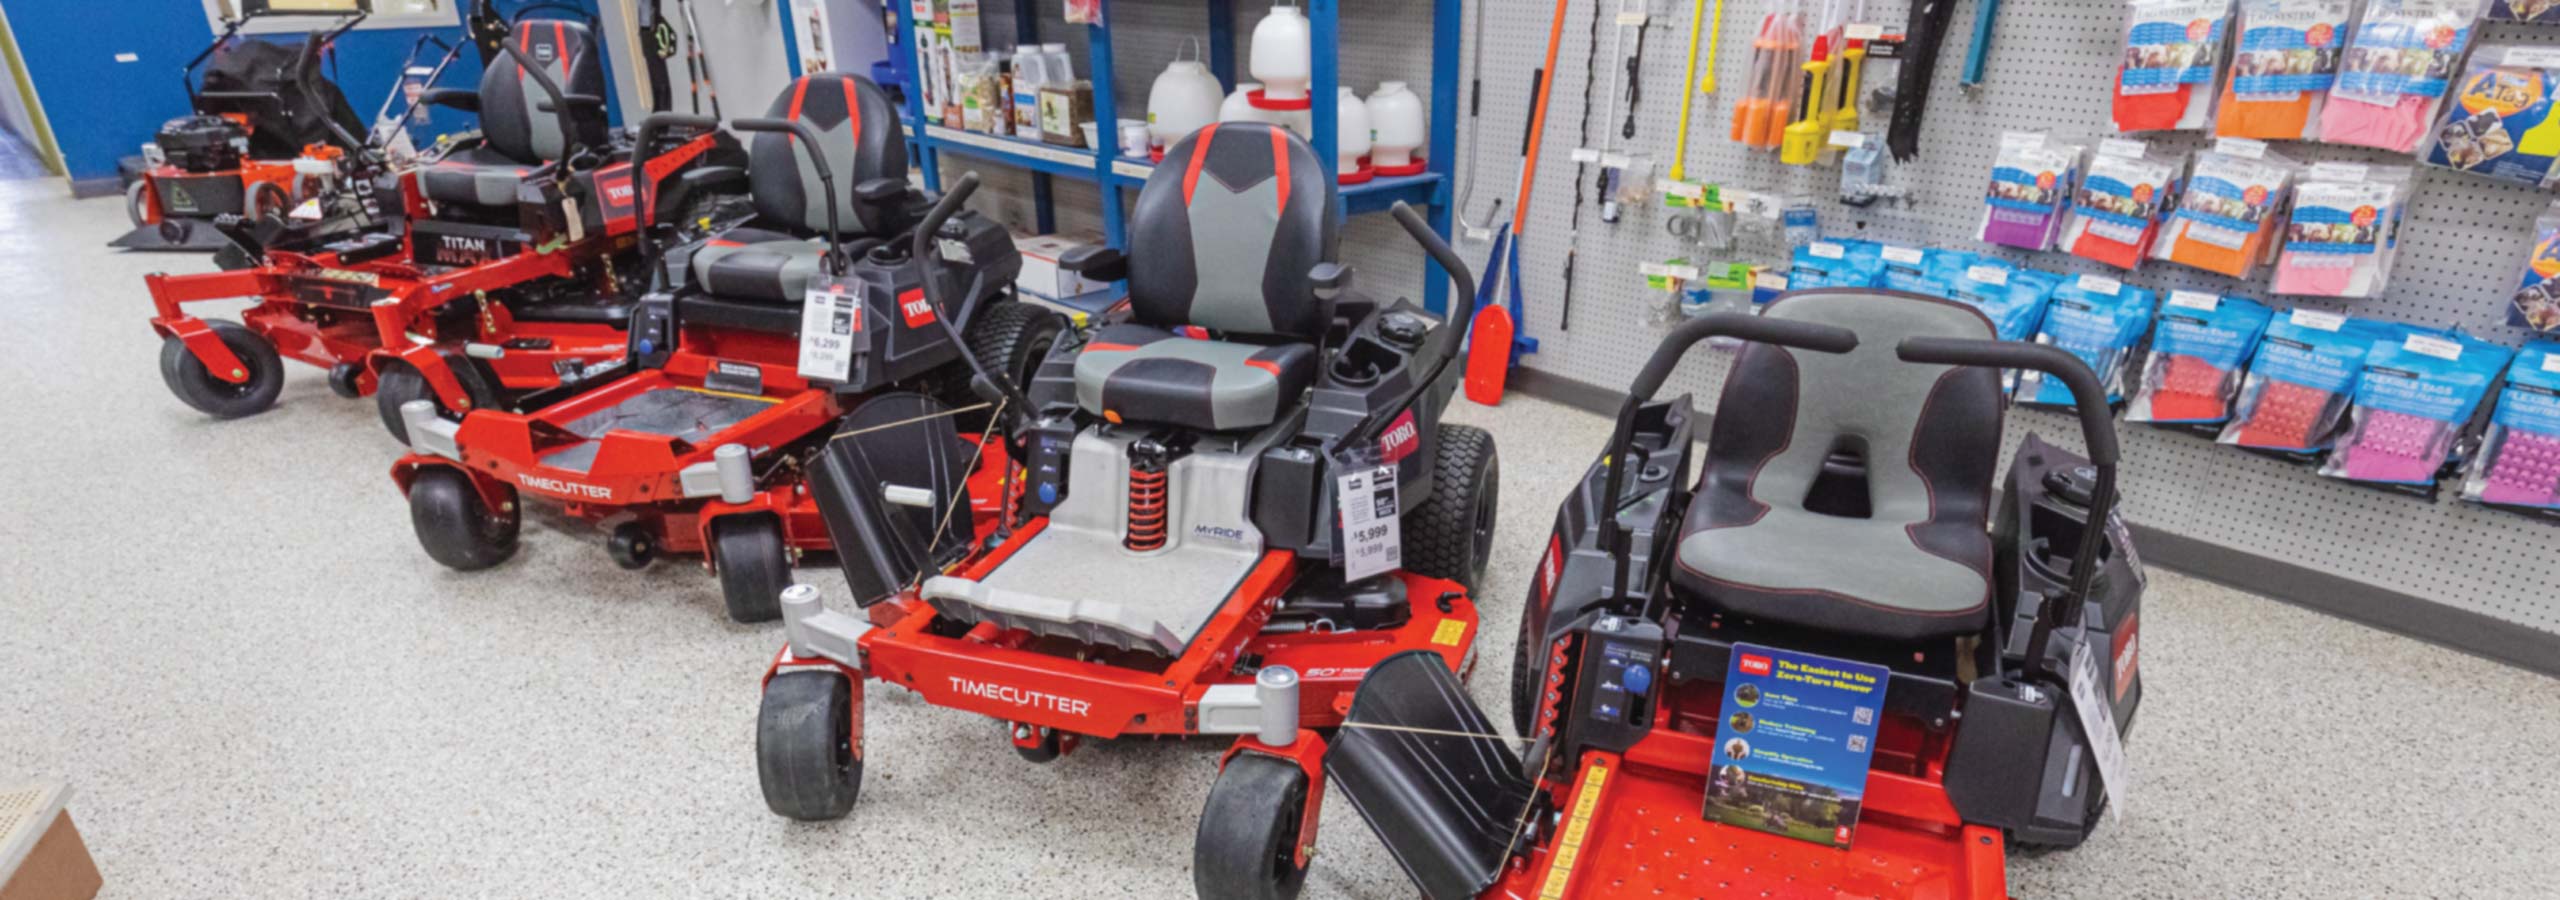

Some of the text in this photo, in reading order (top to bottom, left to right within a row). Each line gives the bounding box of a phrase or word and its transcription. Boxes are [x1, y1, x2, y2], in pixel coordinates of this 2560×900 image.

[441, 234, 485, 252] TITAN
[2421, 382, 2453, 396] TAGS
[1380, 420, 1416, 452] TORO
[517, 472, 612, 500] TIMECUTTER
[1743, 658, 1768, 670] TORO
[1779, 660, 1877, 684] The Easiest to Use
[1776, 671, 1873, 694] Zero-Turn Mower
[947, 675, 1092, 717] TIMECUTTER
